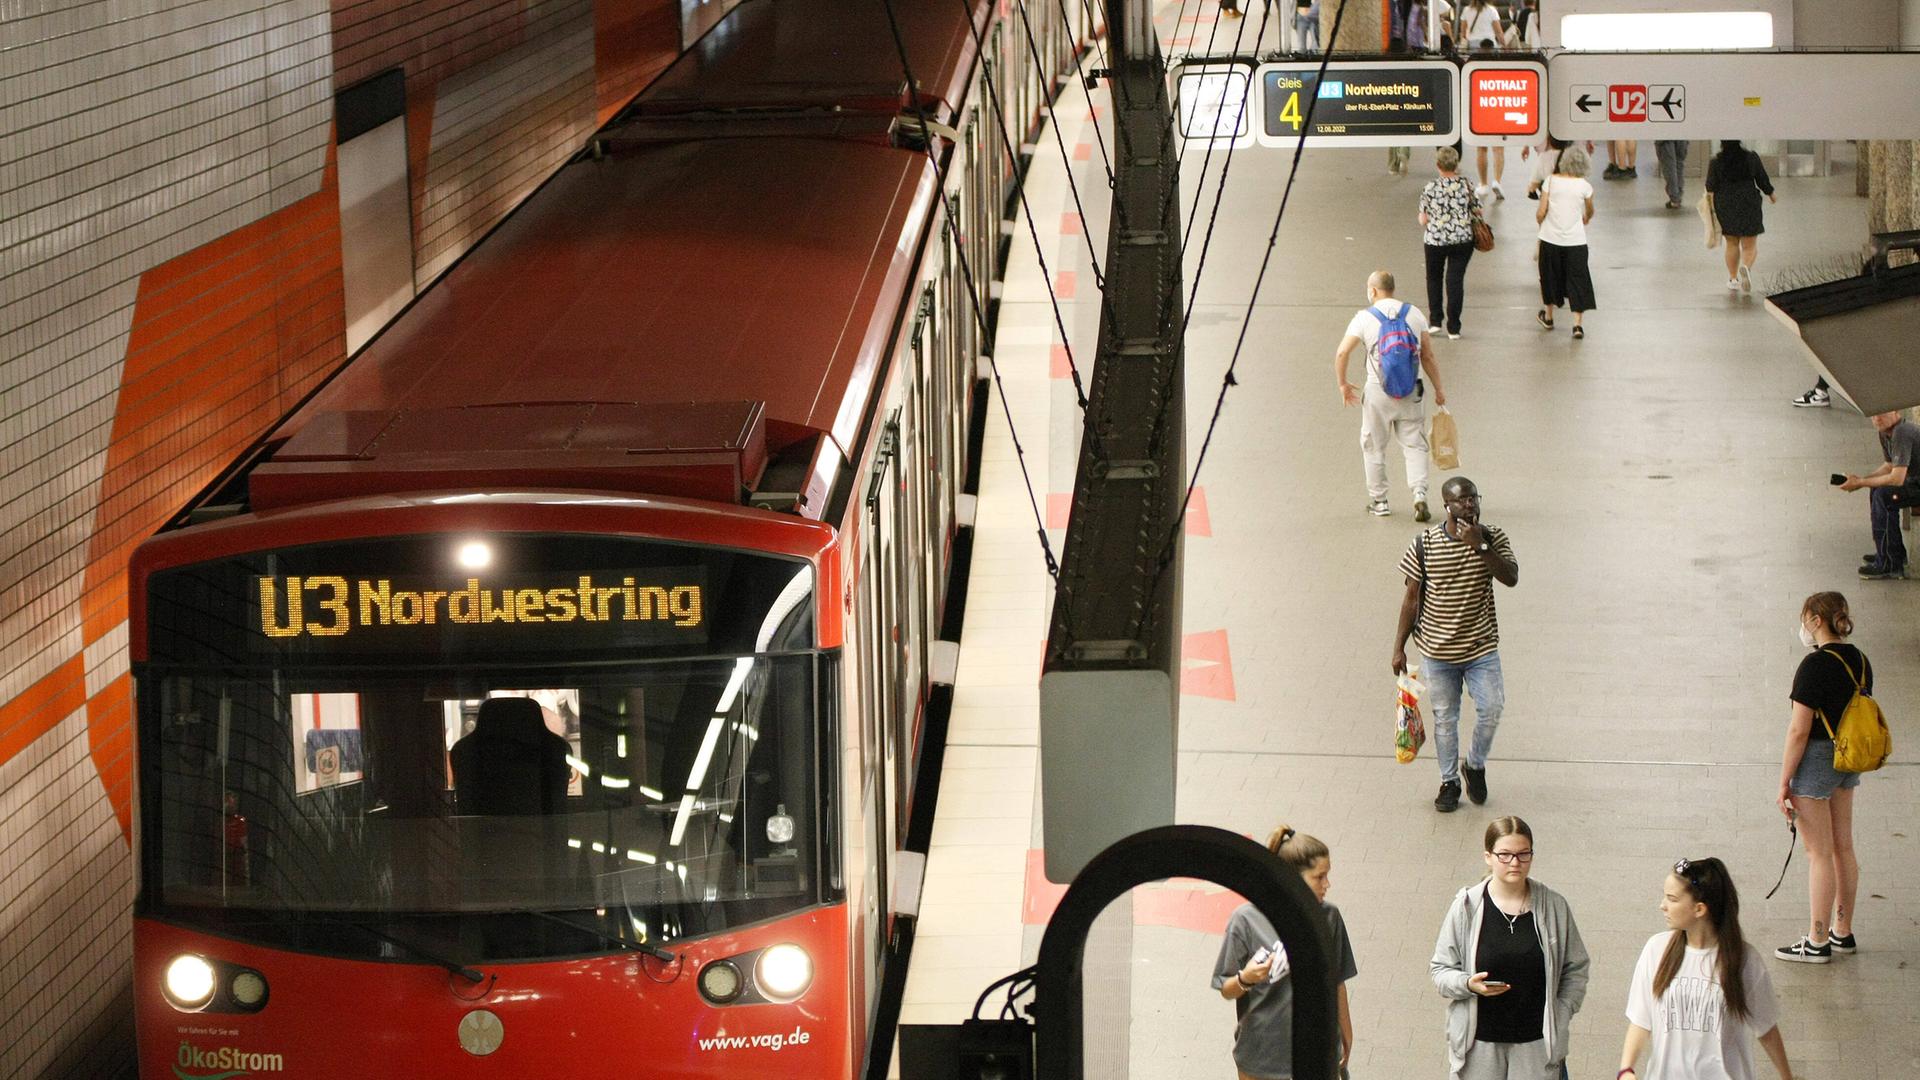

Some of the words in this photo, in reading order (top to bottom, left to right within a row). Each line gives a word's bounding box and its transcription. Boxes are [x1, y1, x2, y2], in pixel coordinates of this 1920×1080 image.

[1277, 77, 1303, 89] Gleis
[1345, 83, 1420, 97] Nordwestring
[1479, 79, 1528, 91] NOTHALT
[1279, 91, 1303, 131] 4
[1479, 96, 1528, 108] NOTRUF
[1610, 91, 1646, 115] U2
[259, 576, 349, 637] U3
[358, 576, 701, 627] Nordwestring
[699, 1025, 810, 1051] www.vag.de
[178, 1040, 283, 1072] ÖkoStrom
